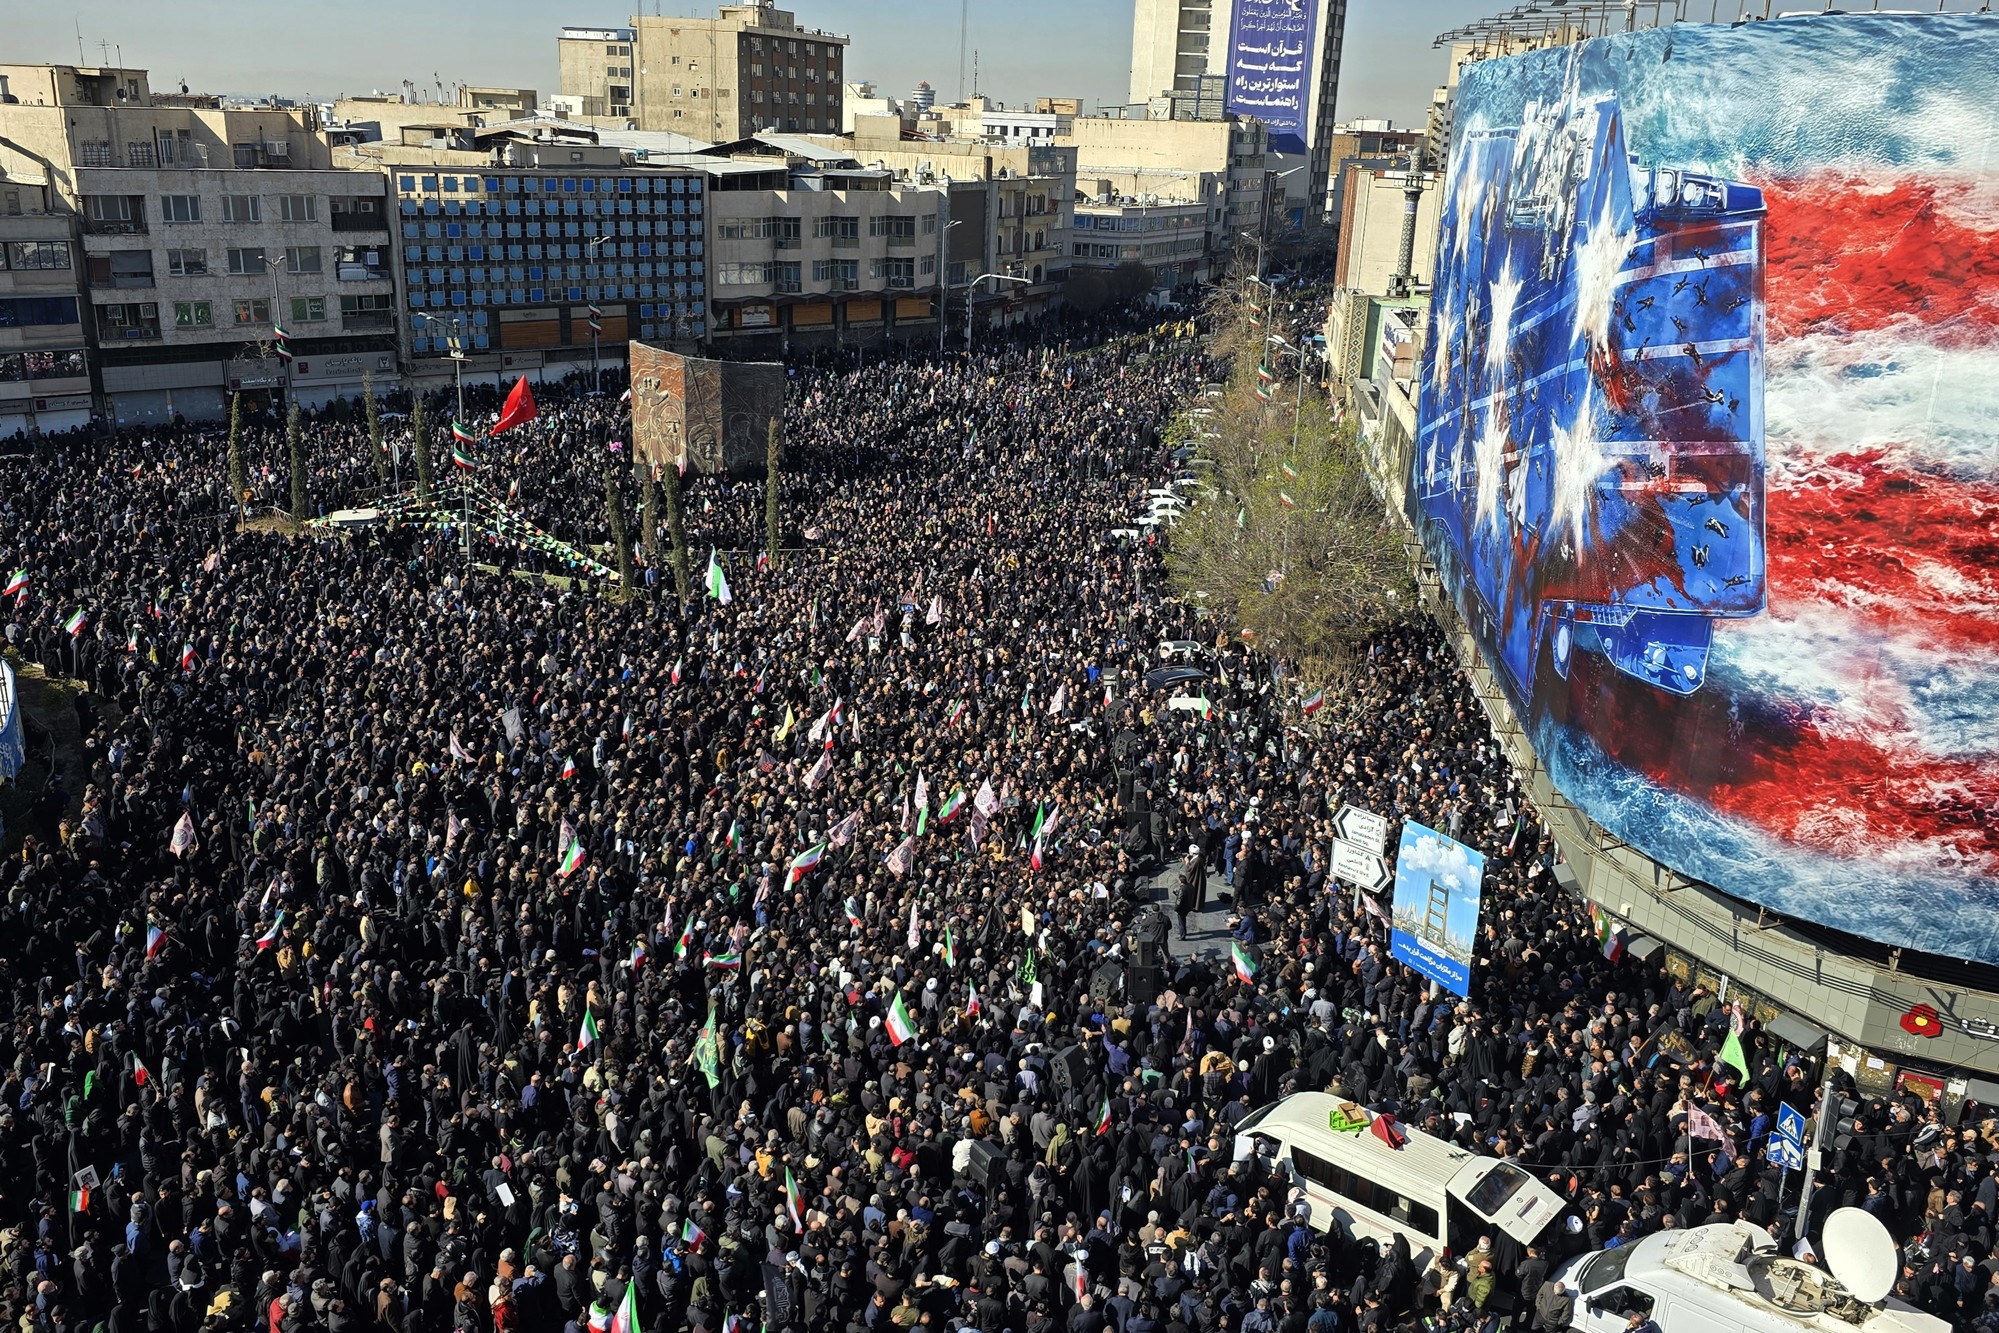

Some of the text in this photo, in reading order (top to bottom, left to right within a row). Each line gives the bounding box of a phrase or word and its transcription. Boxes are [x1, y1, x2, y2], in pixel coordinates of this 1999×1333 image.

[1237, 40, 1303, 58] قرآن است
[1236, 58, 1303, 74] که به
[1235, 75, 1300, 92] استوارترین راه
[1535, 1211, 1554, 1228] TOYOTA
